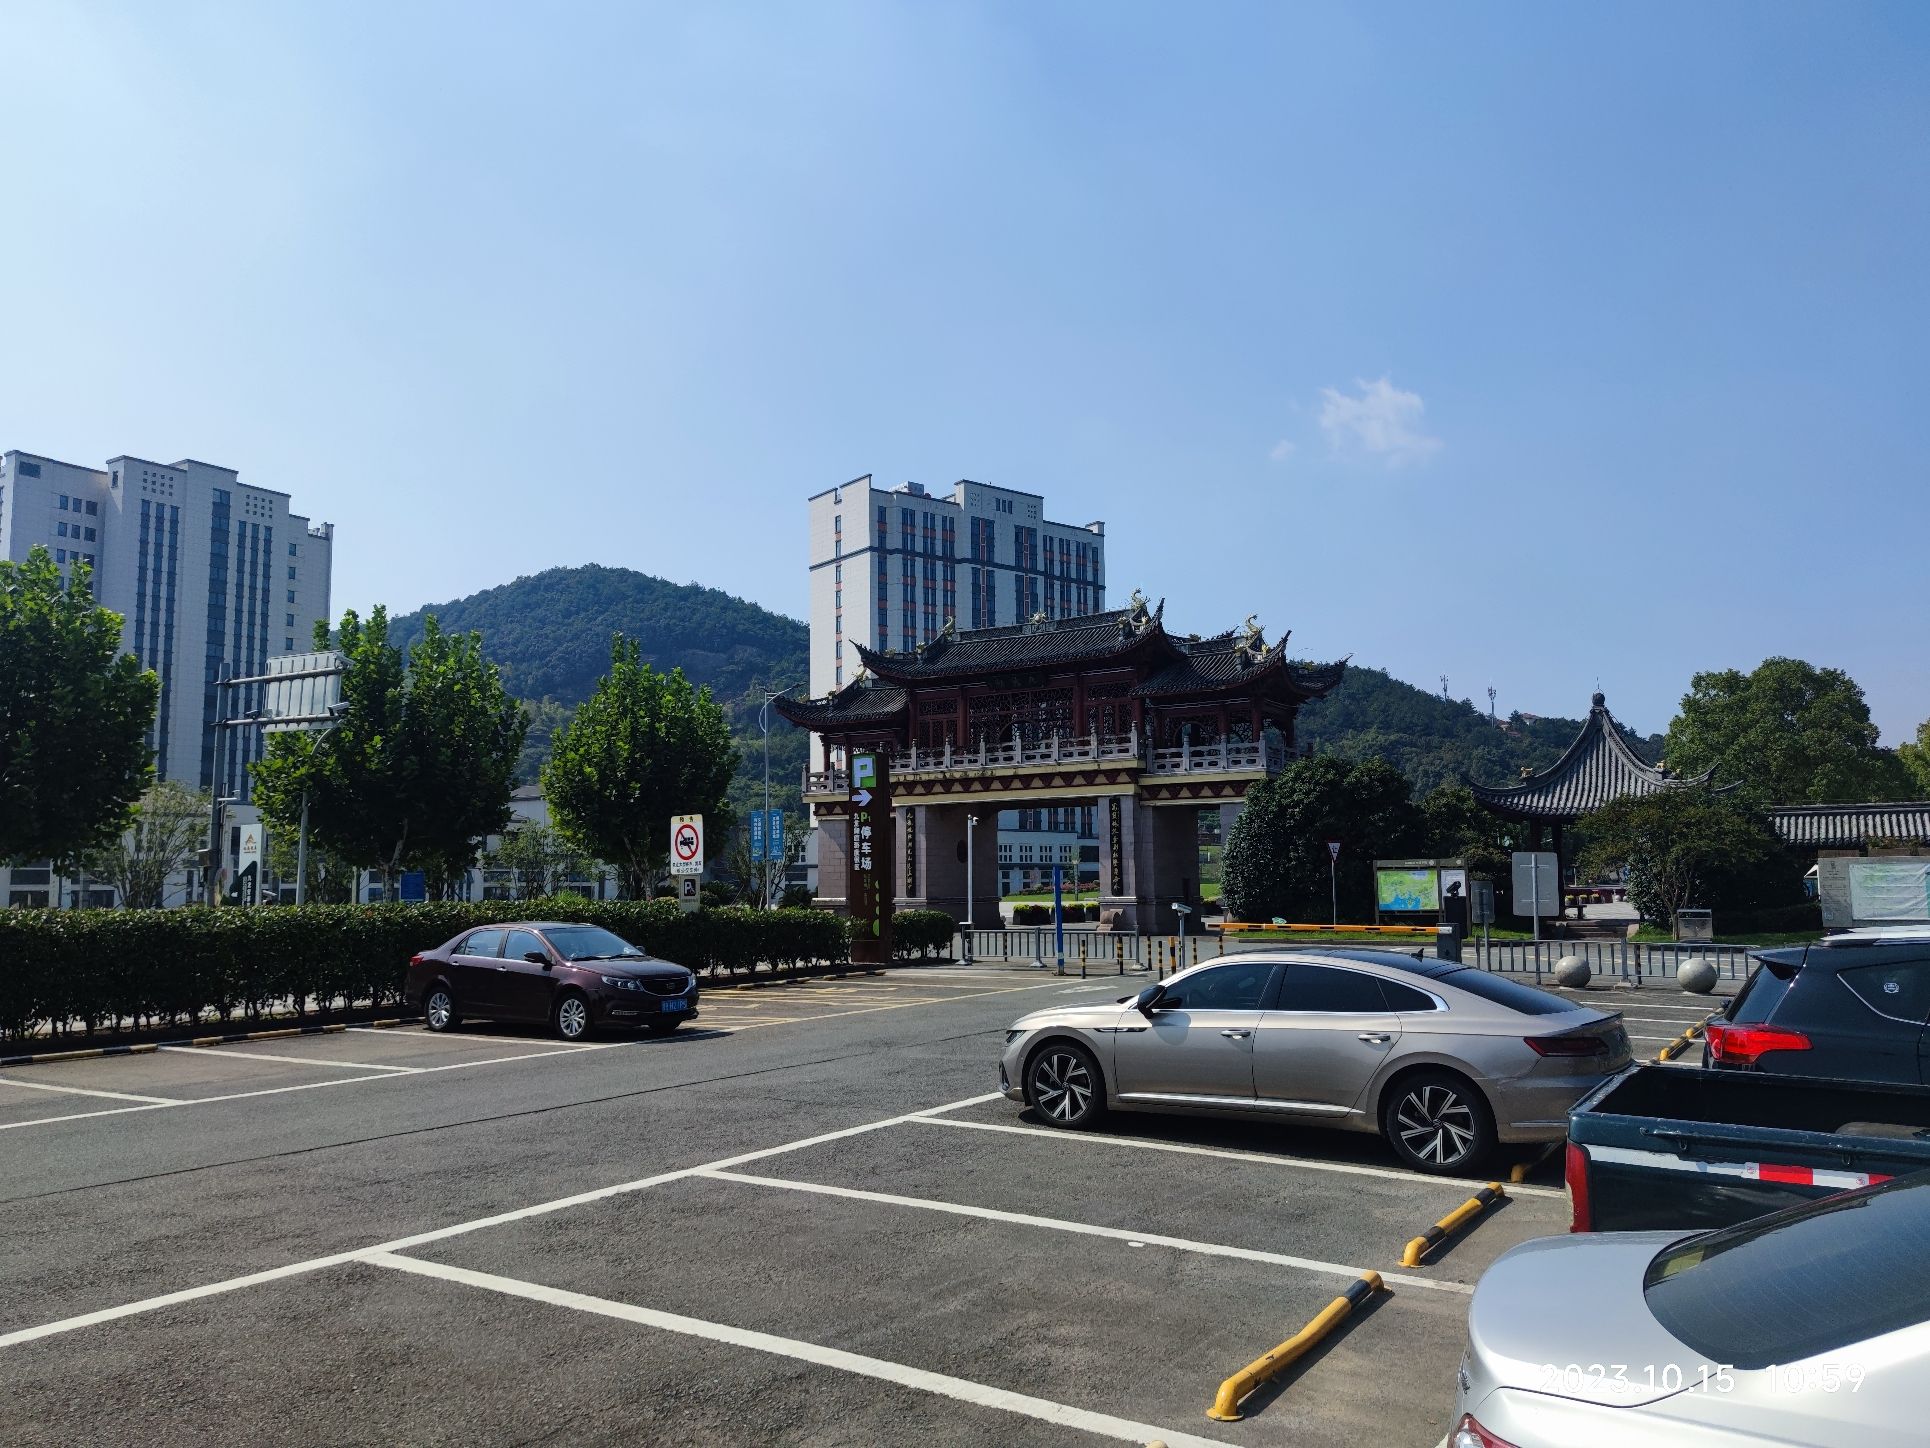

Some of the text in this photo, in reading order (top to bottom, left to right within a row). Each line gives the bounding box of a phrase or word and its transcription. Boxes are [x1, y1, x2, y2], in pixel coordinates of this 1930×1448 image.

[853, 757, 873, 788] P
[860, 825, 873, 871] 停车场
